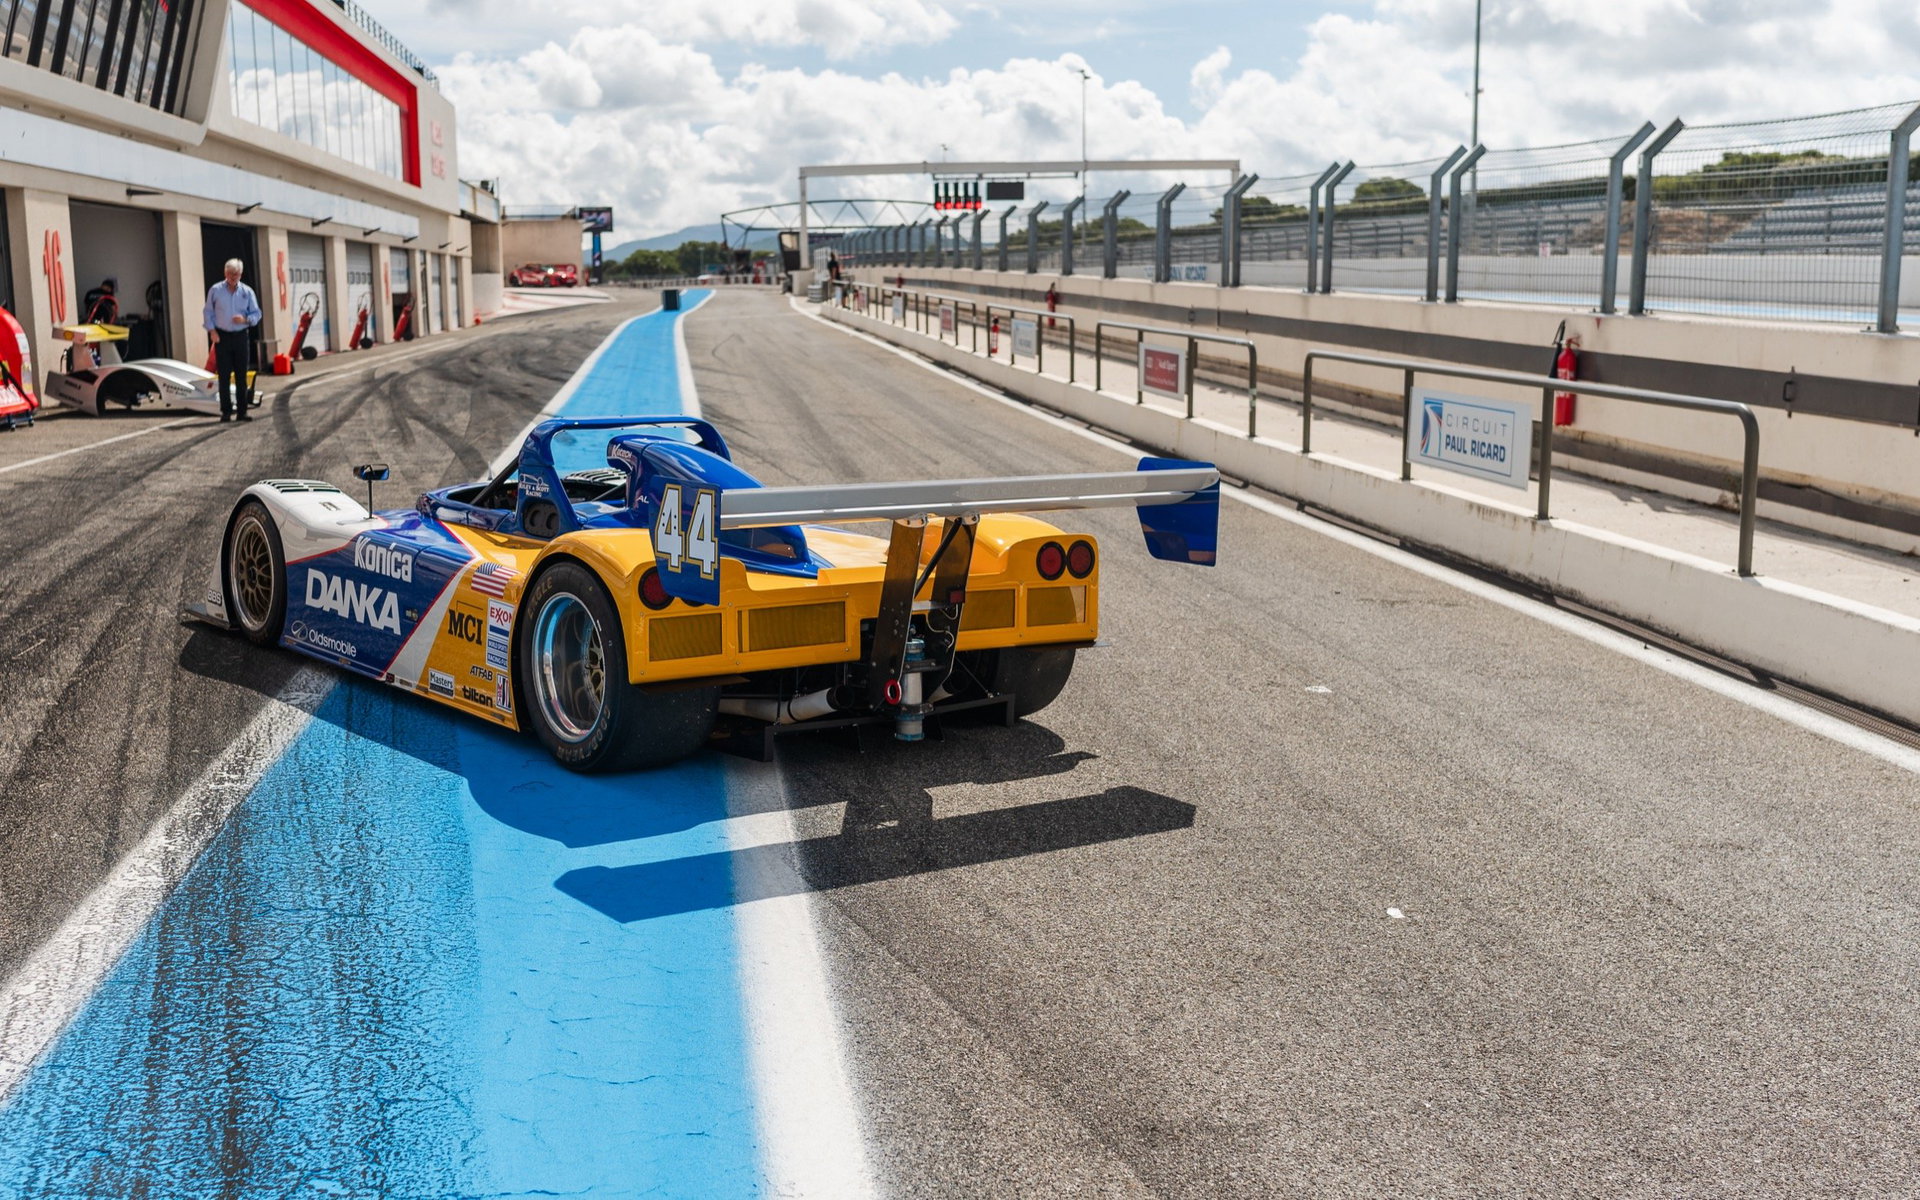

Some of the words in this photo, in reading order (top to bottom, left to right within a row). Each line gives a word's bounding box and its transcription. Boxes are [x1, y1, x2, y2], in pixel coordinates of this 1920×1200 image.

[43, 229, 66, 324] 16
[1446, 414, 1508, 437] CIRCUIT
[1445, 435, 1467, 458] PAUL
[1470, 440, 1506, 463] RICARD
[655, 483, 718, 581] 44
[354, 535, 413, 583] Konica
[207, 590, 222, 606] BBS
[305, 568, 401, 635] DANKA
[448, 609, 483, 645] MCI
[308, 629, 357, 657] Oldsmobile
[430, 671, 453, 689] Masters
[461, 685, 493, 708] tilton
